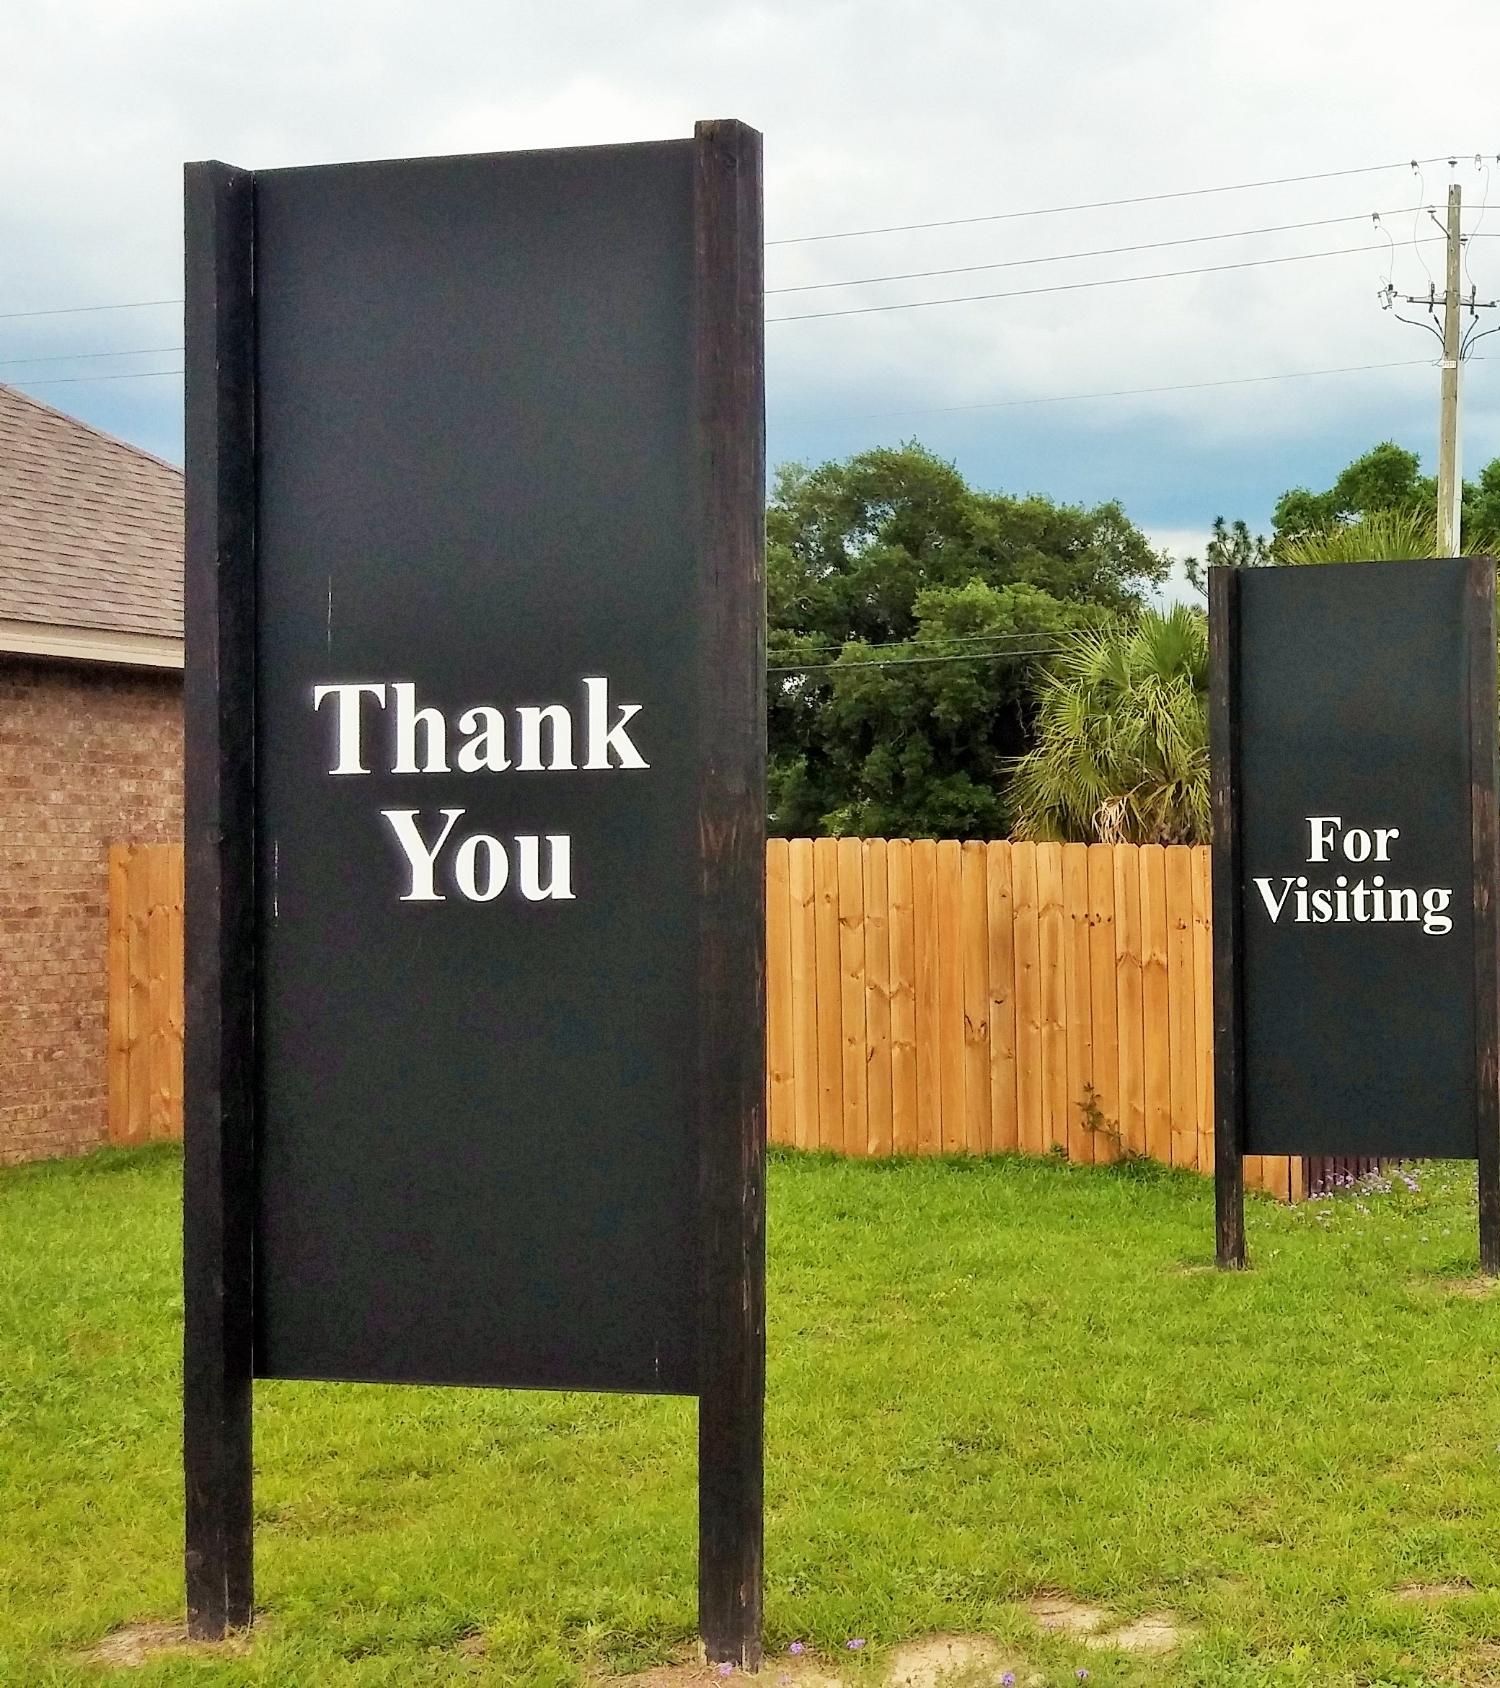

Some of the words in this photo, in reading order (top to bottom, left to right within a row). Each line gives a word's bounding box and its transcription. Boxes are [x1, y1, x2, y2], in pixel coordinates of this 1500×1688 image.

[311, 678, 650, 774] Thank
[381, 809, 577, 902] You
[1305, 817, 1400, 862] For
[1253, 876, 1453, 934] Visiting
